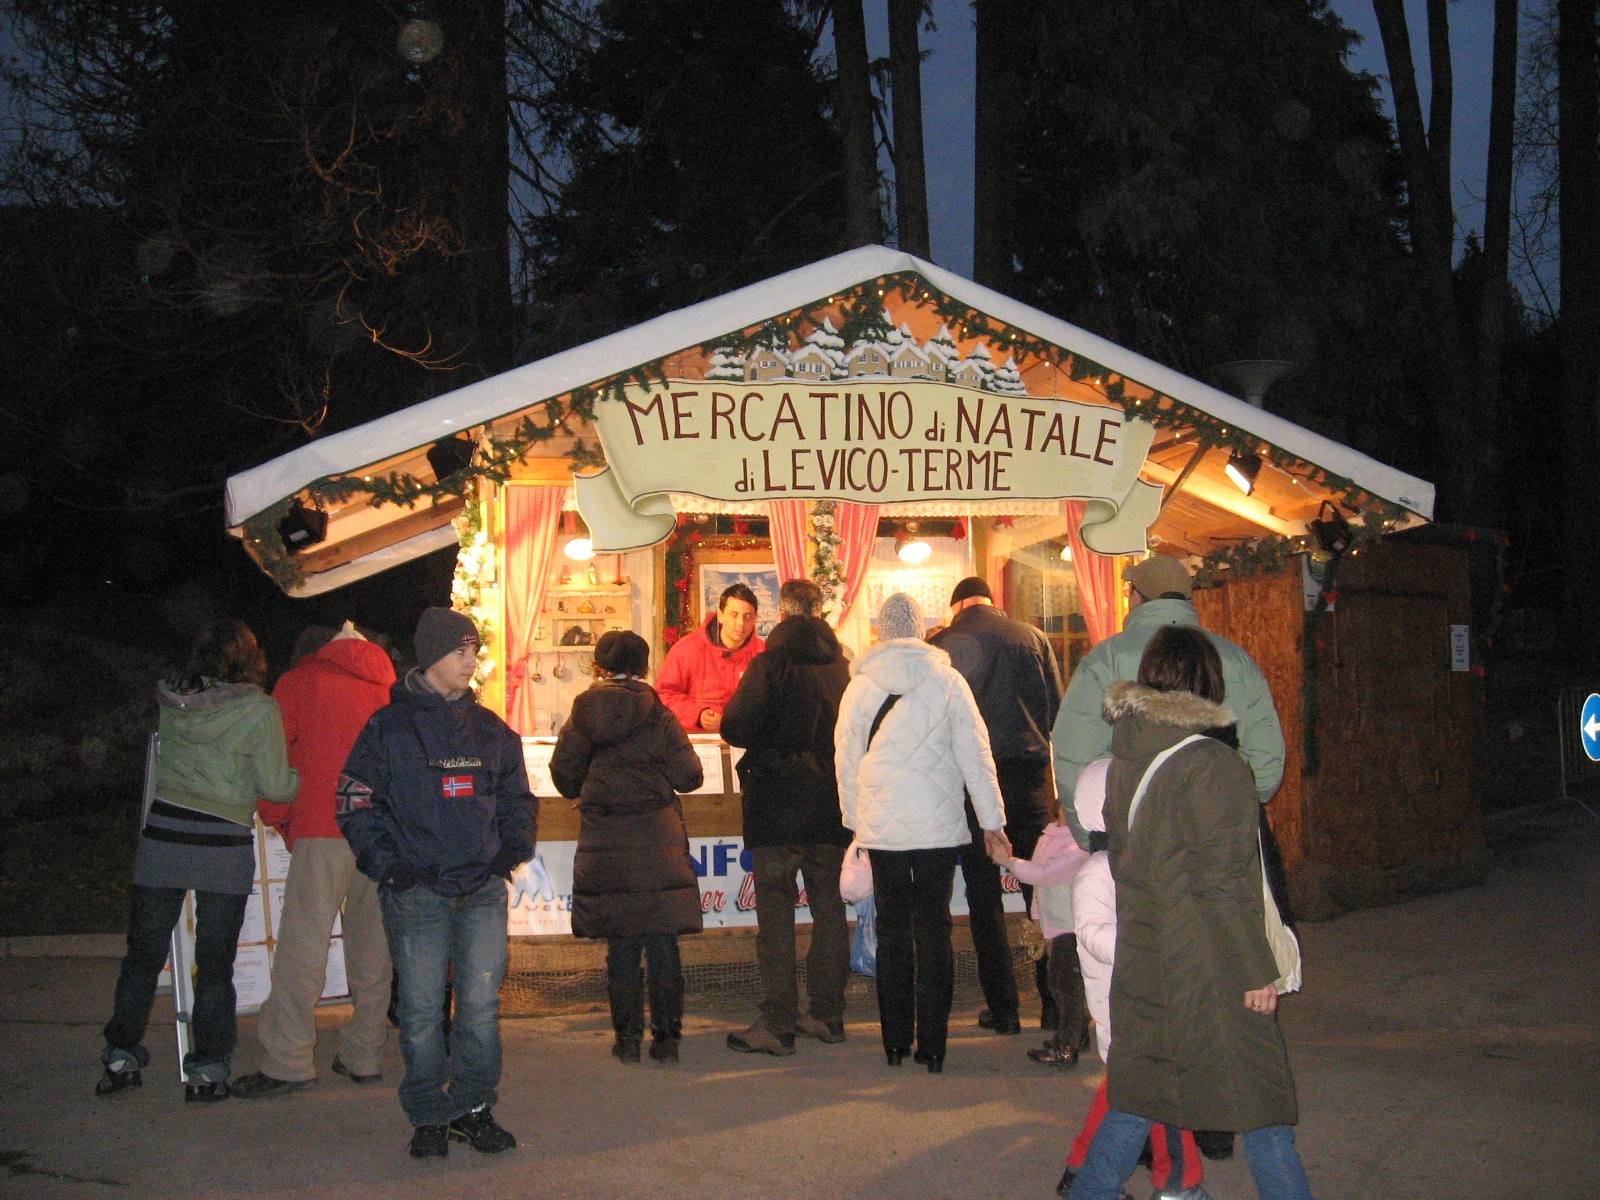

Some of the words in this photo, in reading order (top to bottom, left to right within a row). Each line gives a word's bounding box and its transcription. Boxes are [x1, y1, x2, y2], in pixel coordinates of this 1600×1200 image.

[624, 391, 913, 446] MERCATINO
[924, 410, 946, 443] di
[956, 396, 1121, 466] NATALE
[734, 457, 756, 493] di
[762, 447, 1013, 493] LEVICO-TERME
